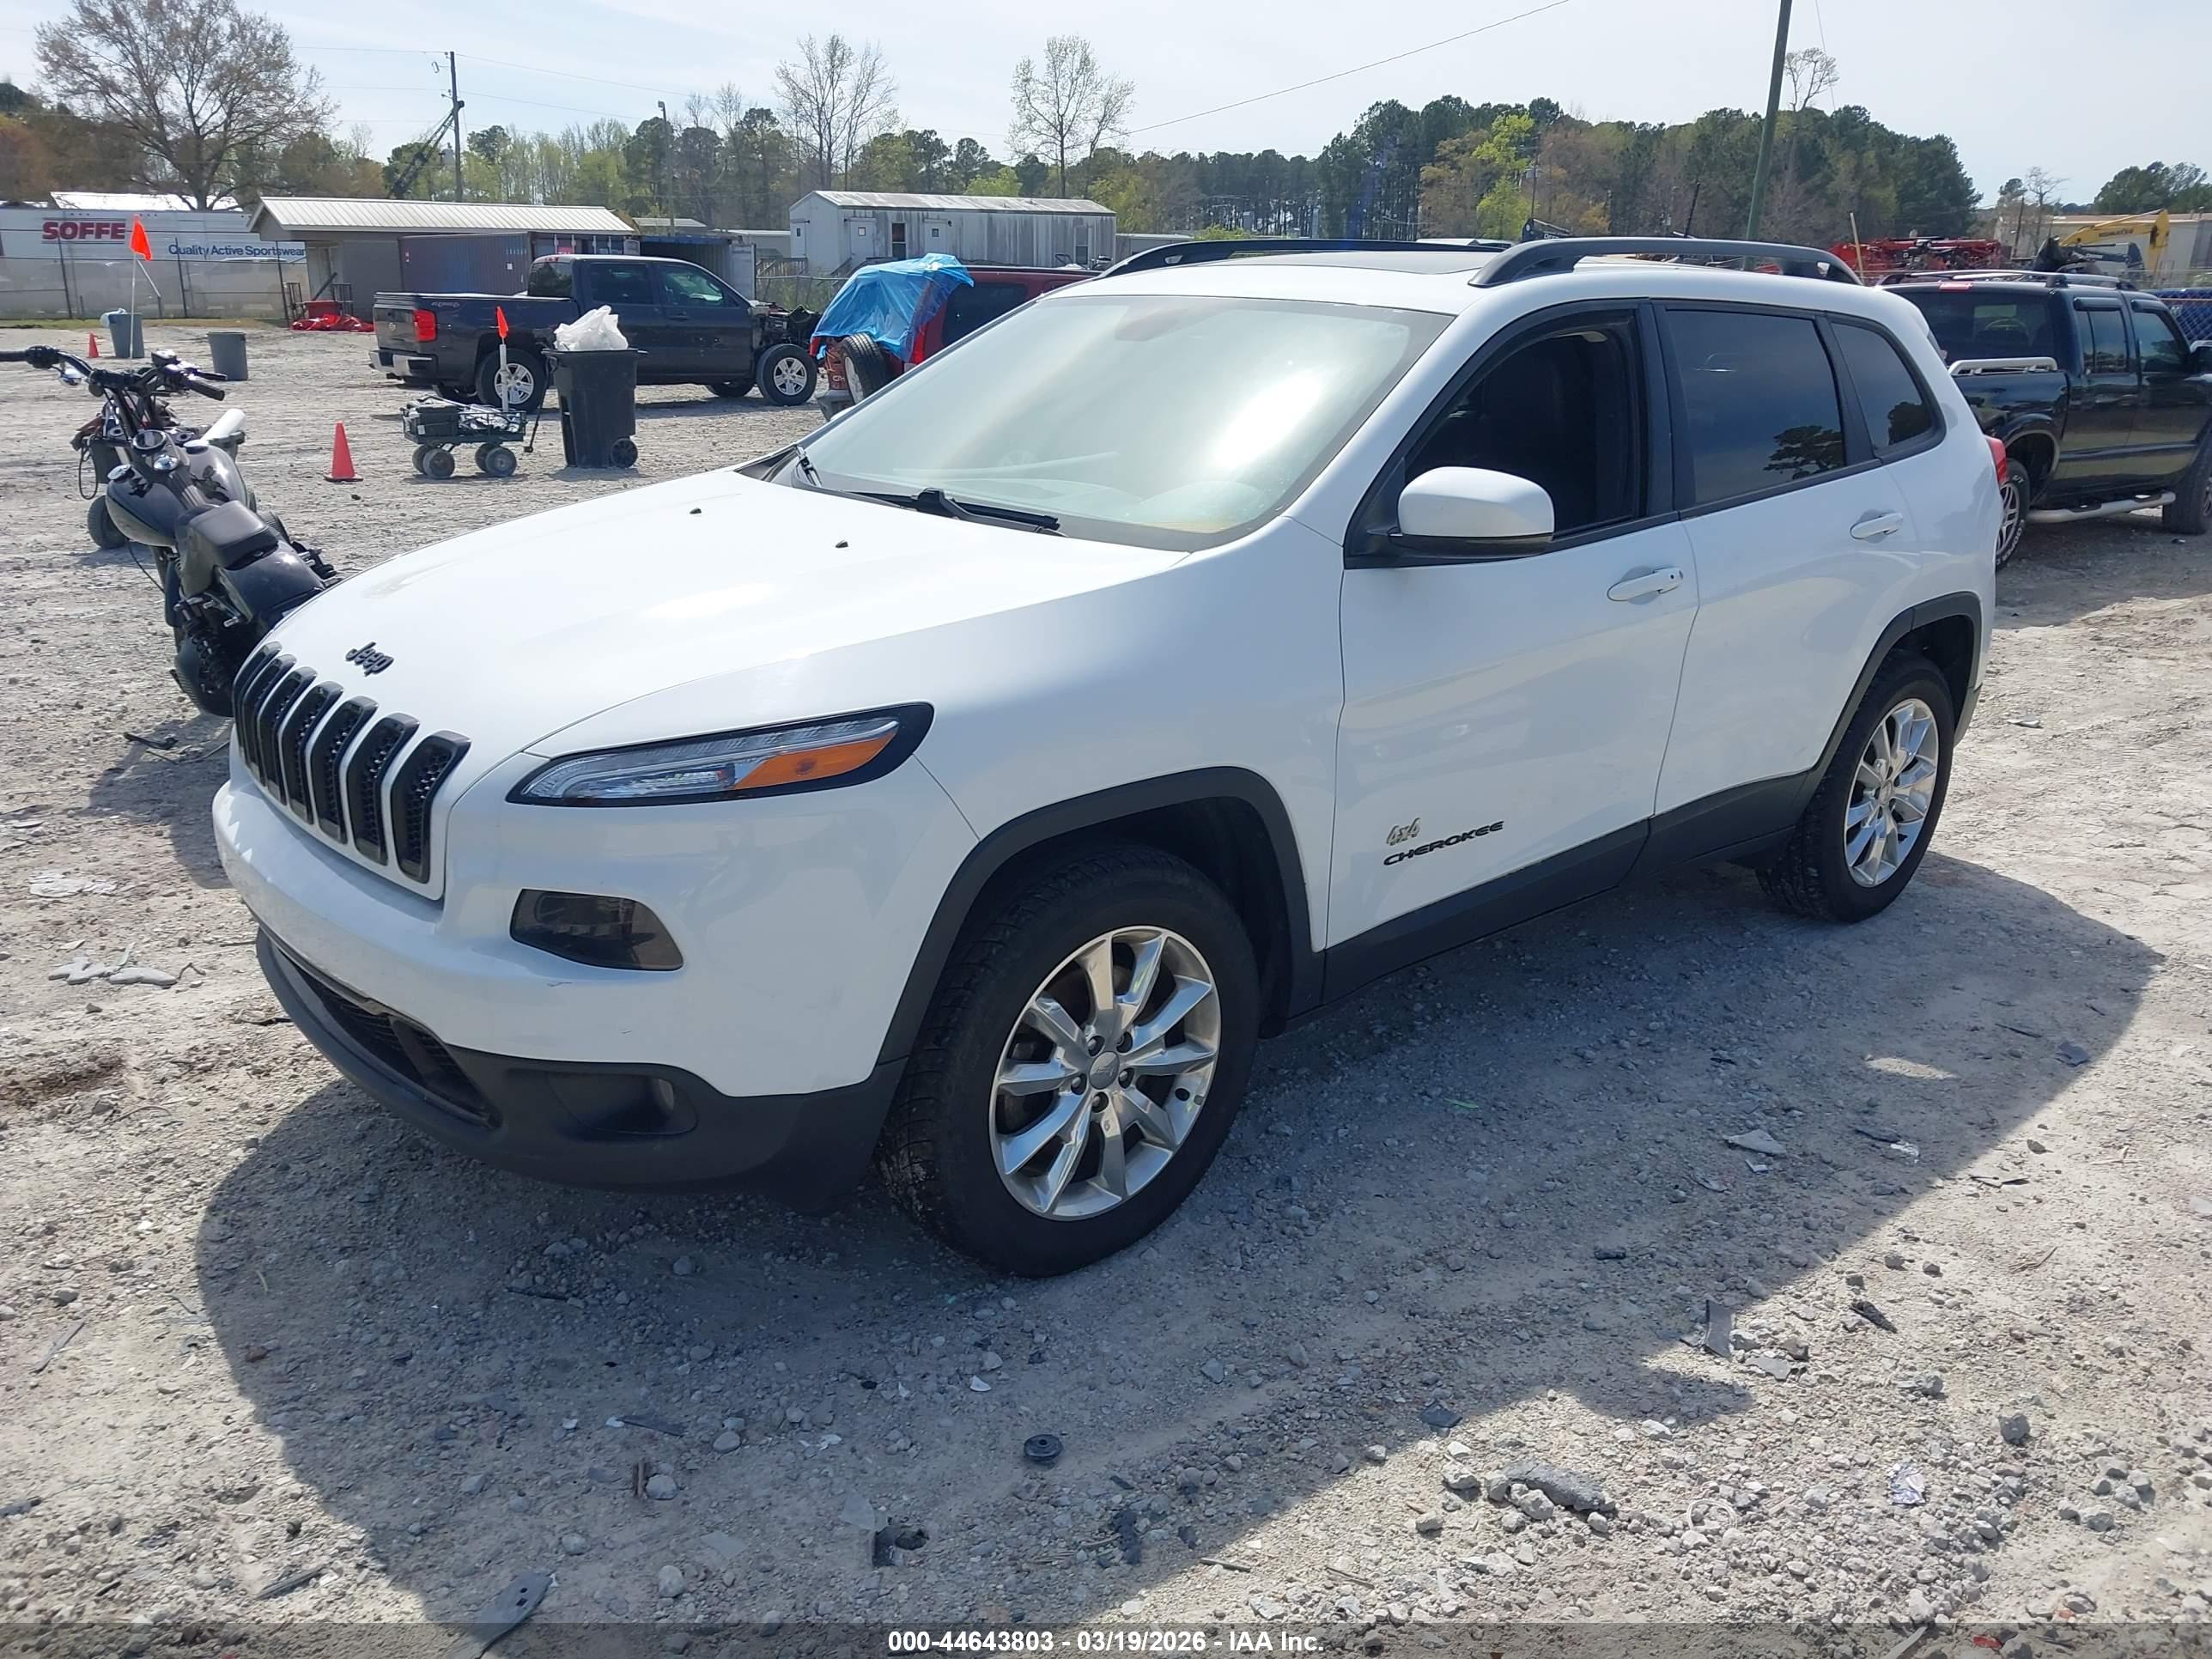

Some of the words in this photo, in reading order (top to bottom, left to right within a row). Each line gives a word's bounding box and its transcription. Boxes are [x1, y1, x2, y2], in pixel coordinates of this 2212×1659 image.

[42, 221, 125, 240] SOFFE
[167, 244, 209, 257] Quality
[211, 244, 244, 255] Active
[245, 244, 306, 257] Sportswear
[345, 641, 394, 677] Jeep
[1383, 821, 1504, 866] CHEROKEE
[1386, 817, 1420, 846] 4x4
